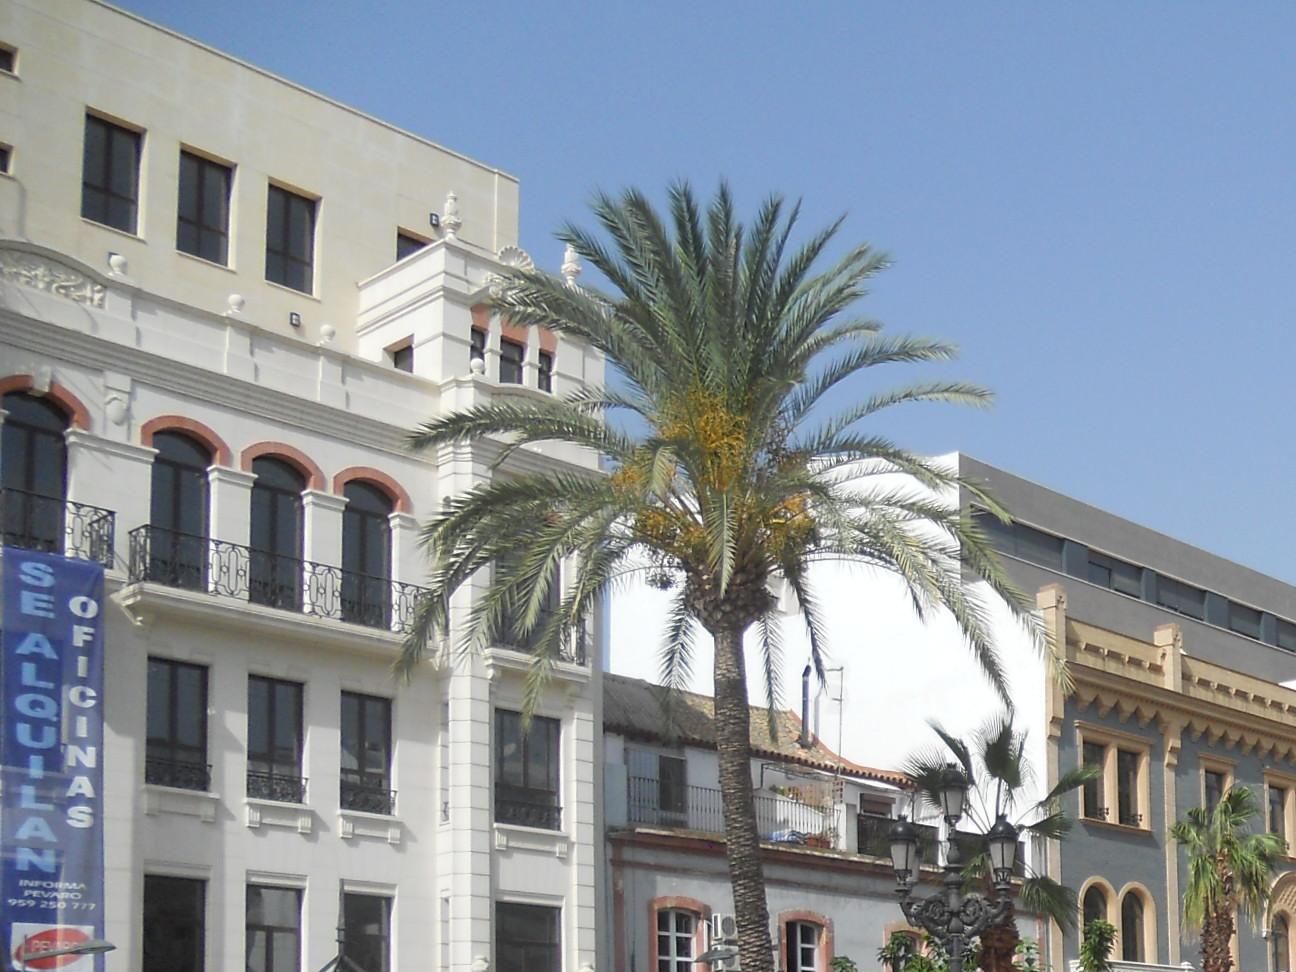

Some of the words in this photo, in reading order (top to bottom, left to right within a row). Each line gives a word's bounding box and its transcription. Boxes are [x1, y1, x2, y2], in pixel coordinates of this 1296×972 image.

[19, 561, 55, 619] SE
[14, 632, 59, 873] ALQUILAN
[65, 595, 98, 829] OFICINAS
[18, 879, 86, 890] INFORMA
